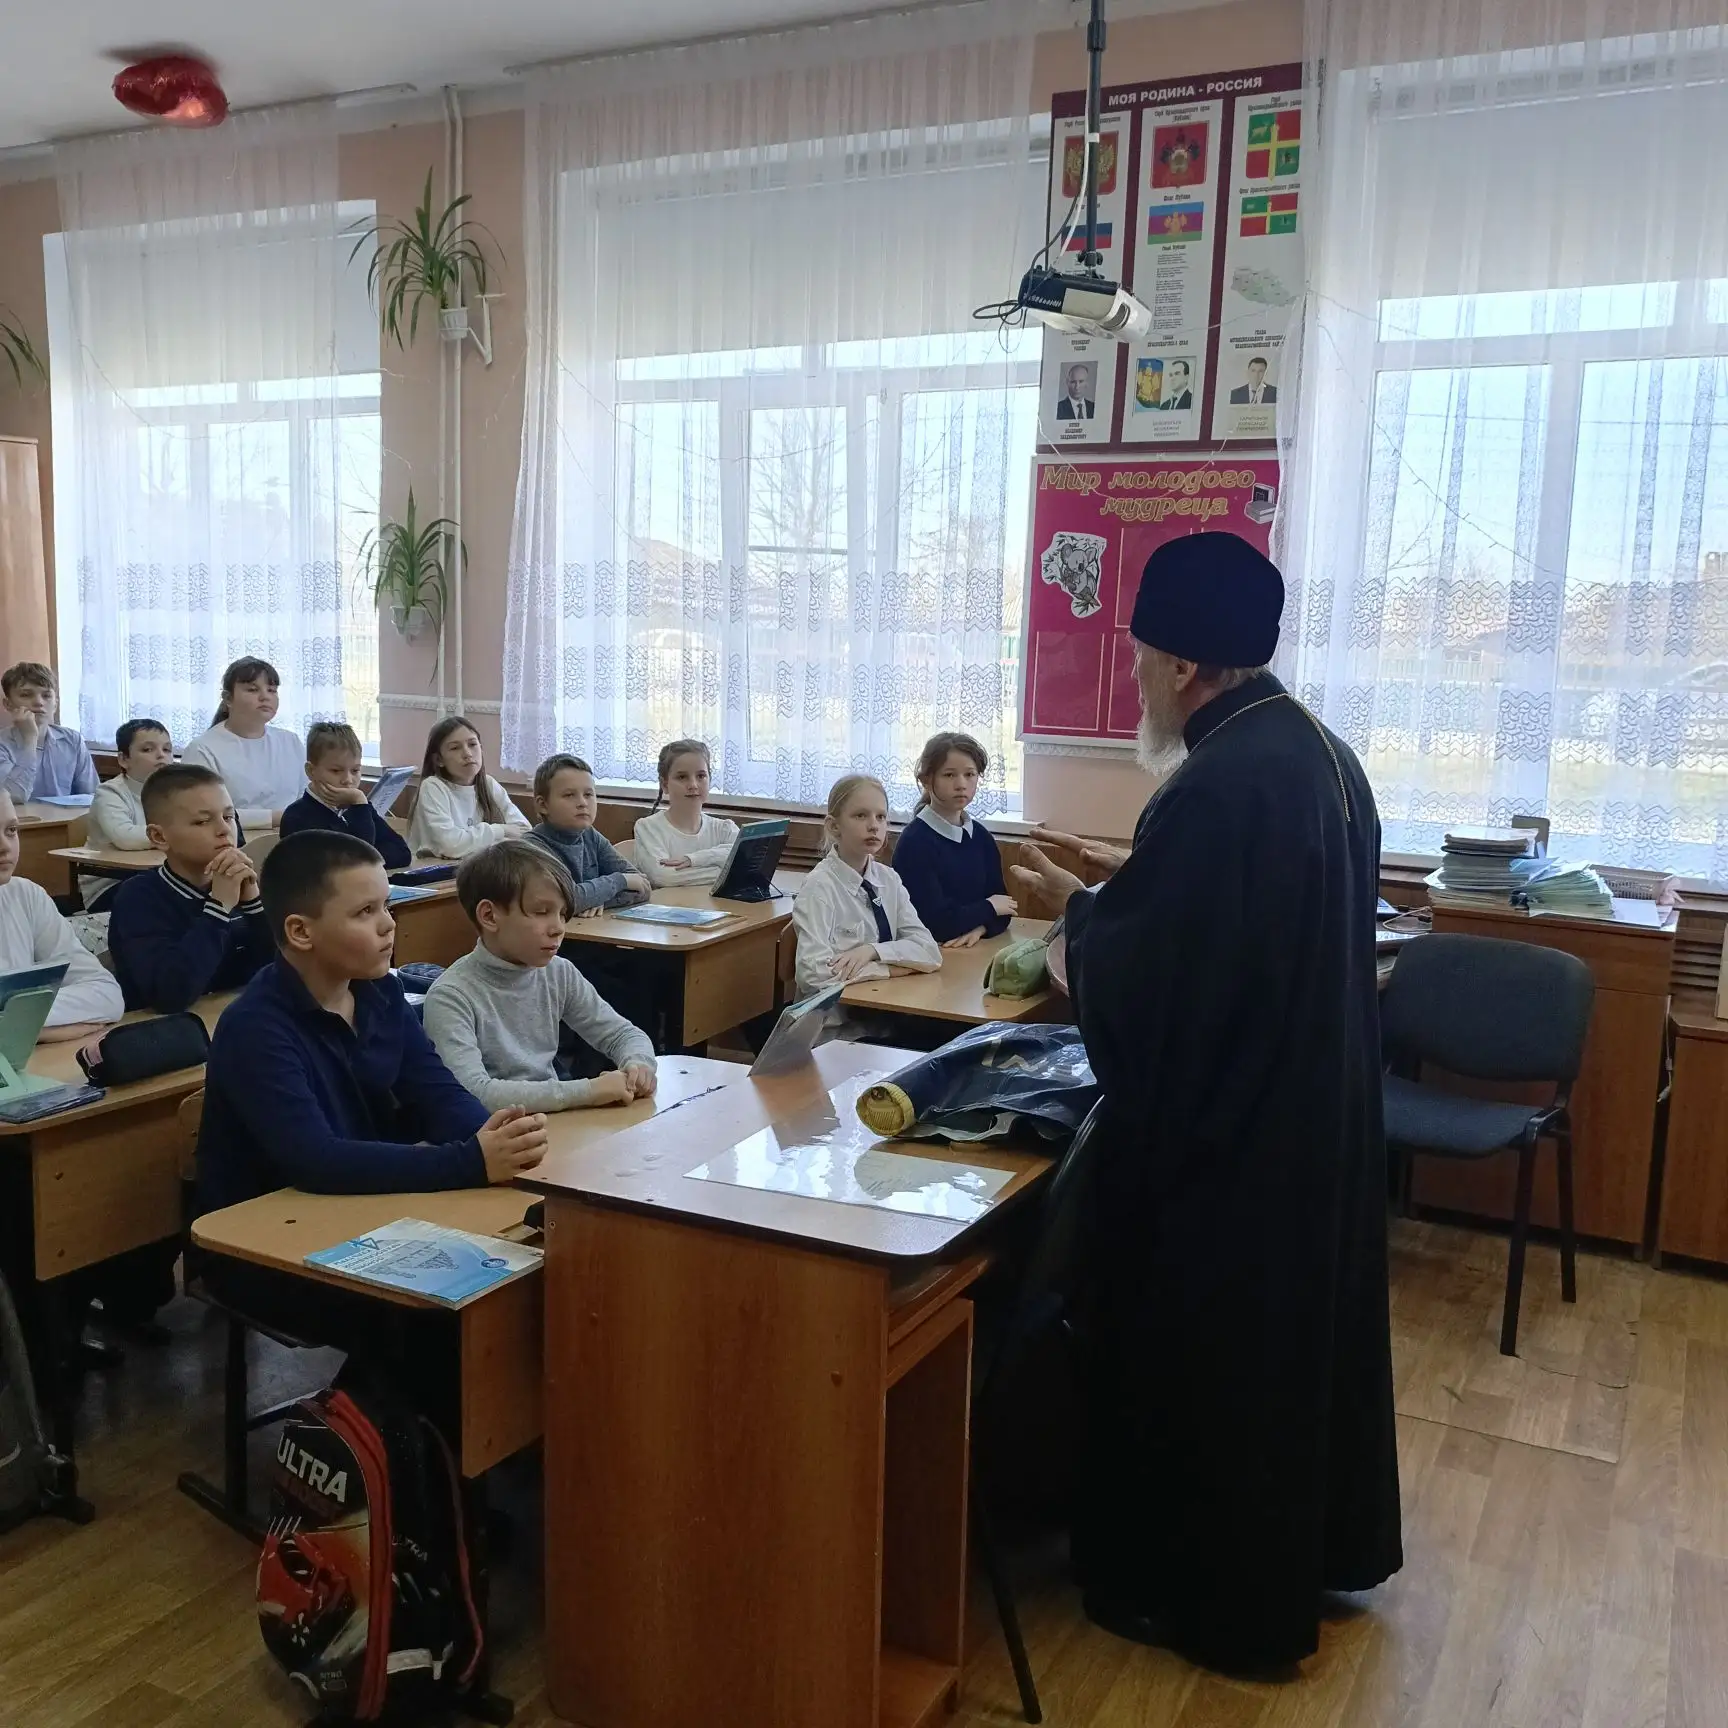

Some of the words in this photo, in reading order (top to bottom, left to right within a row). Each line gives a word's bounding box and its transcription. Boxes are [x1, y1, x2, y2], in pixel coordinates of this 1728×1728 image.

[1108, 92, 1137, 106] МОЯ
[1140, 85, 1195, 102] РОДИНА
[1206, 76, 1262, 94] РОССИЯ
[1040, 465, 1101, 495] Мир
[1108, 469, 1256, 495] молодого
[1100, 496, 1229, 522] мудреца
[277, 1432, 348, 1503] ULTRA
